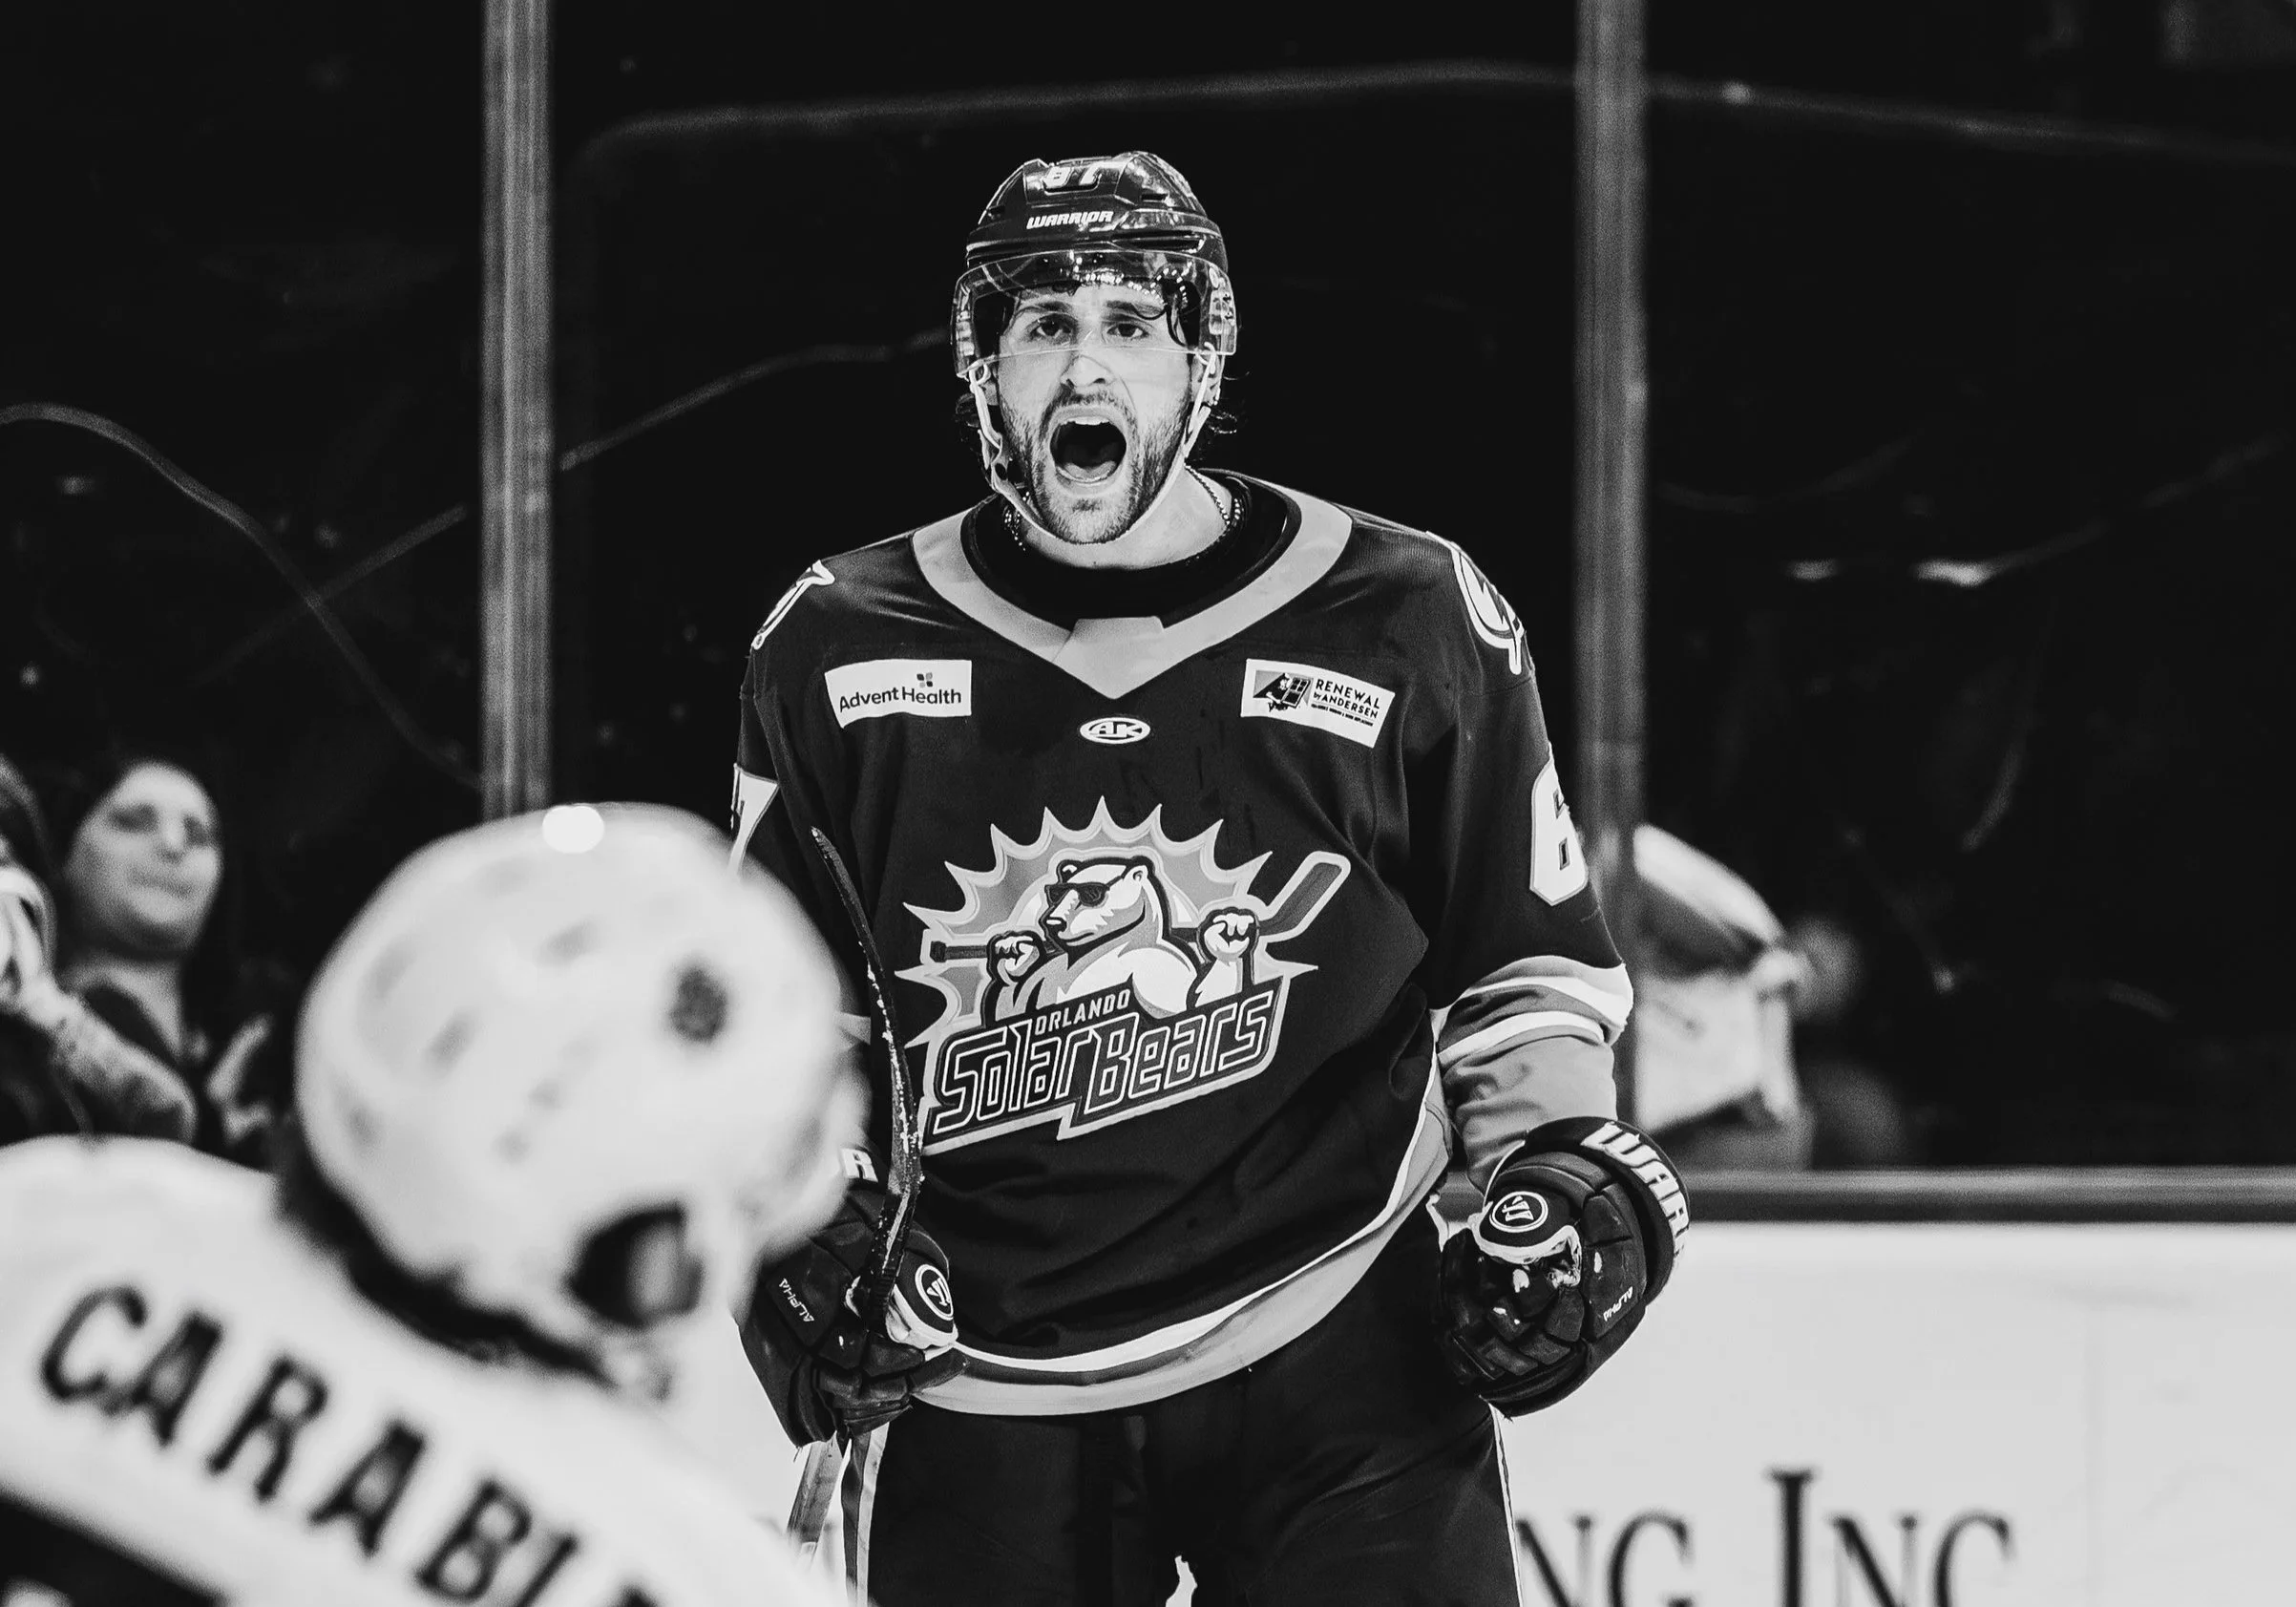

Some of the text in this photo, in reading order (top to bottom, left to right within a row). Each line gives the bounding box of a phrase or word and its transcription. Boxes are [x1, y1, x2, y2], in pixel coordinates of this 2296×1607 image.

[1026, 210, 1114, 229] WARRIOR
[1316, 678, 1380, 709] RENEWAL
[1321, 693, 1379, 719] ANDERSEN
[1034, 988, 1131, 1037] ORLANDO
[778, 1278, 815, 1322] ALPHA
